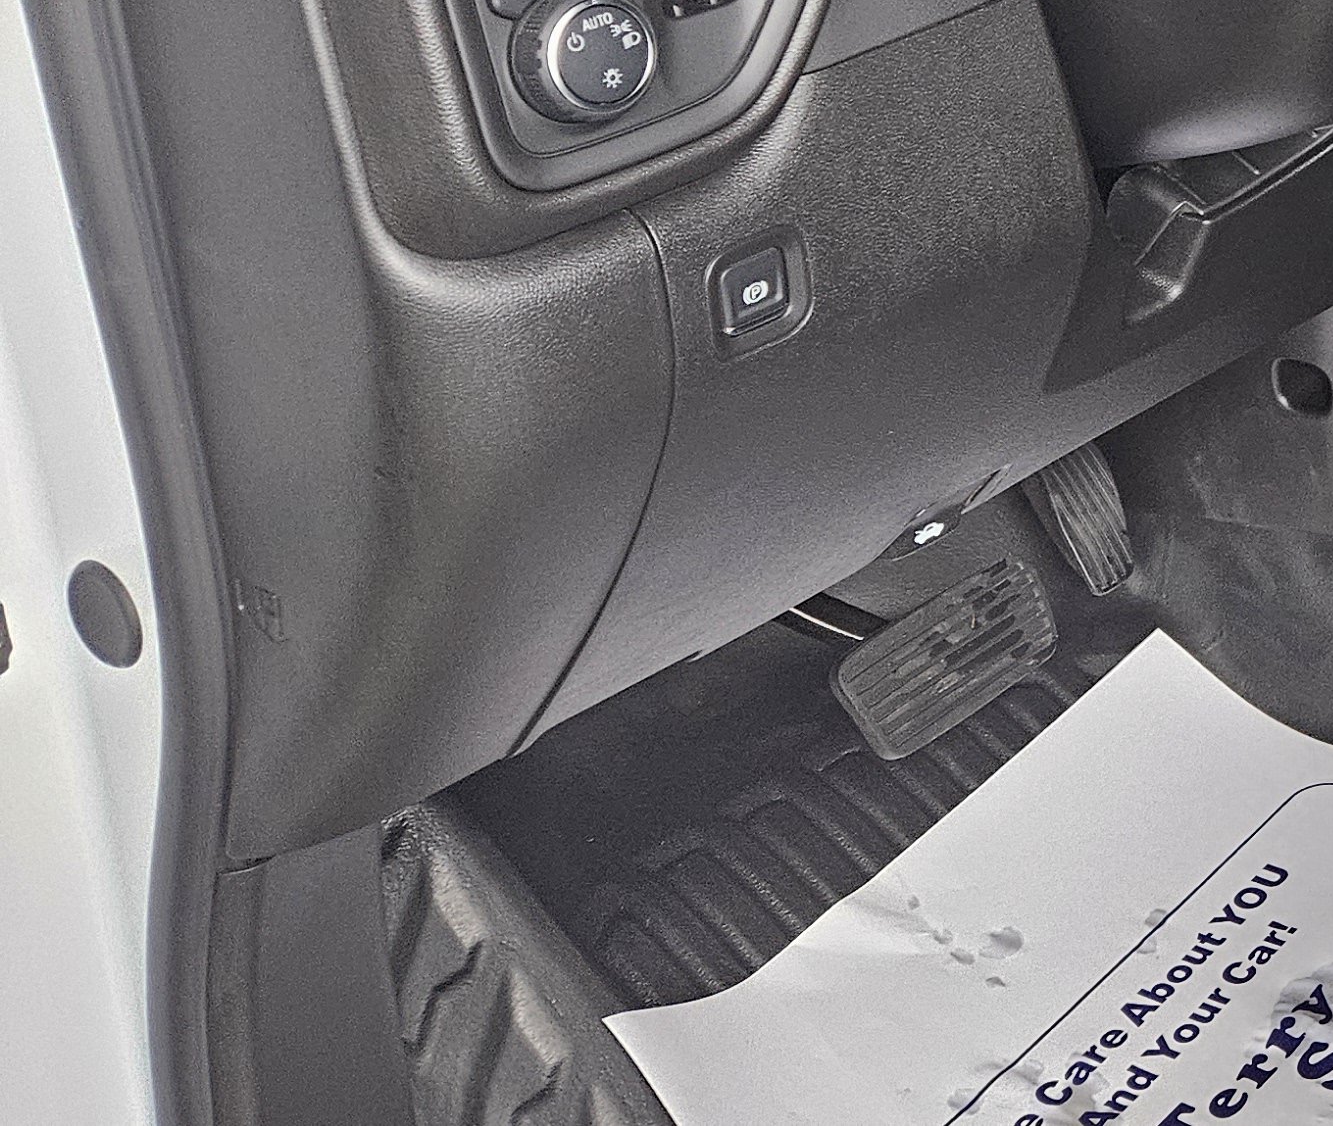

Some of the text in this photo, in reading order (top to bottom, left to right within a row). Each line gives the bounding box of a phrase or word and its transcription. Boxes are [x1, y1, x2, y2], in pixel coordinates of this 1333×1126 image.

[582, 11, 614, 32] AUTO
[1035, 863, 1289, 1106] Care About YOU
[1078, 920, 1298, 1126] And Your Car!
